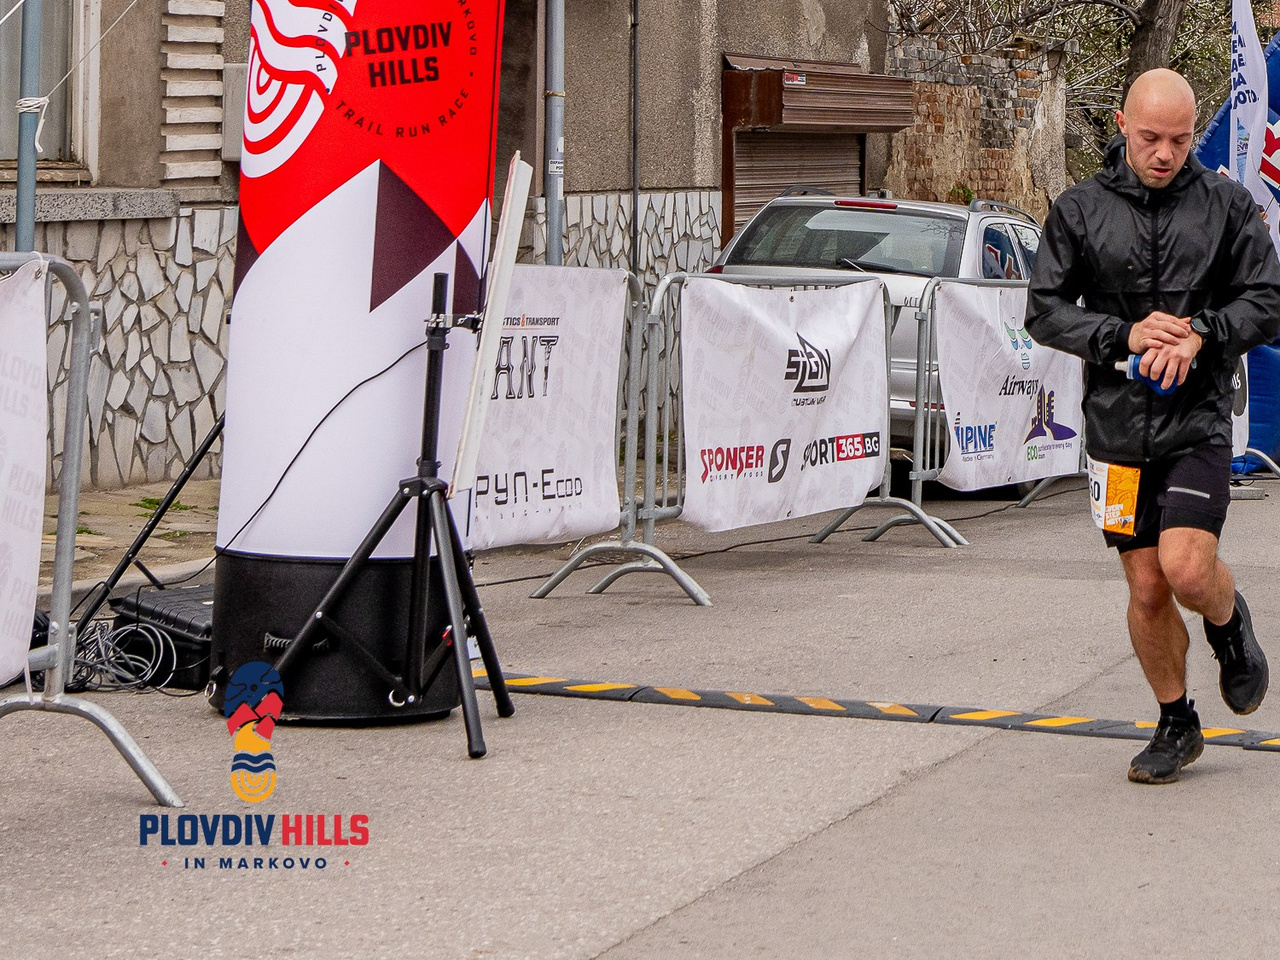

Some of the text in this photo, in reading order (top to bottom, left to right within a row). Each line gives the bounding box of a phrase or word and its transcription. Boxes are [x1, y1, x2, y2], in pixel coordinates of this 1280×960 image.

[345, 21, 452, 58] PLOVDIV
[368, 56, 440, 88] HILLS
[336, 88, 468, 138] TRAIL RUN RACE
[503, 316, 521, 327] TICS
[526, 316, 560, 327] TRANSPORT
[999, 374, 1040, 400] Airways
[700, 445, 764, 484] SPONSER
[1026, 444, 1038, 461] ECO
